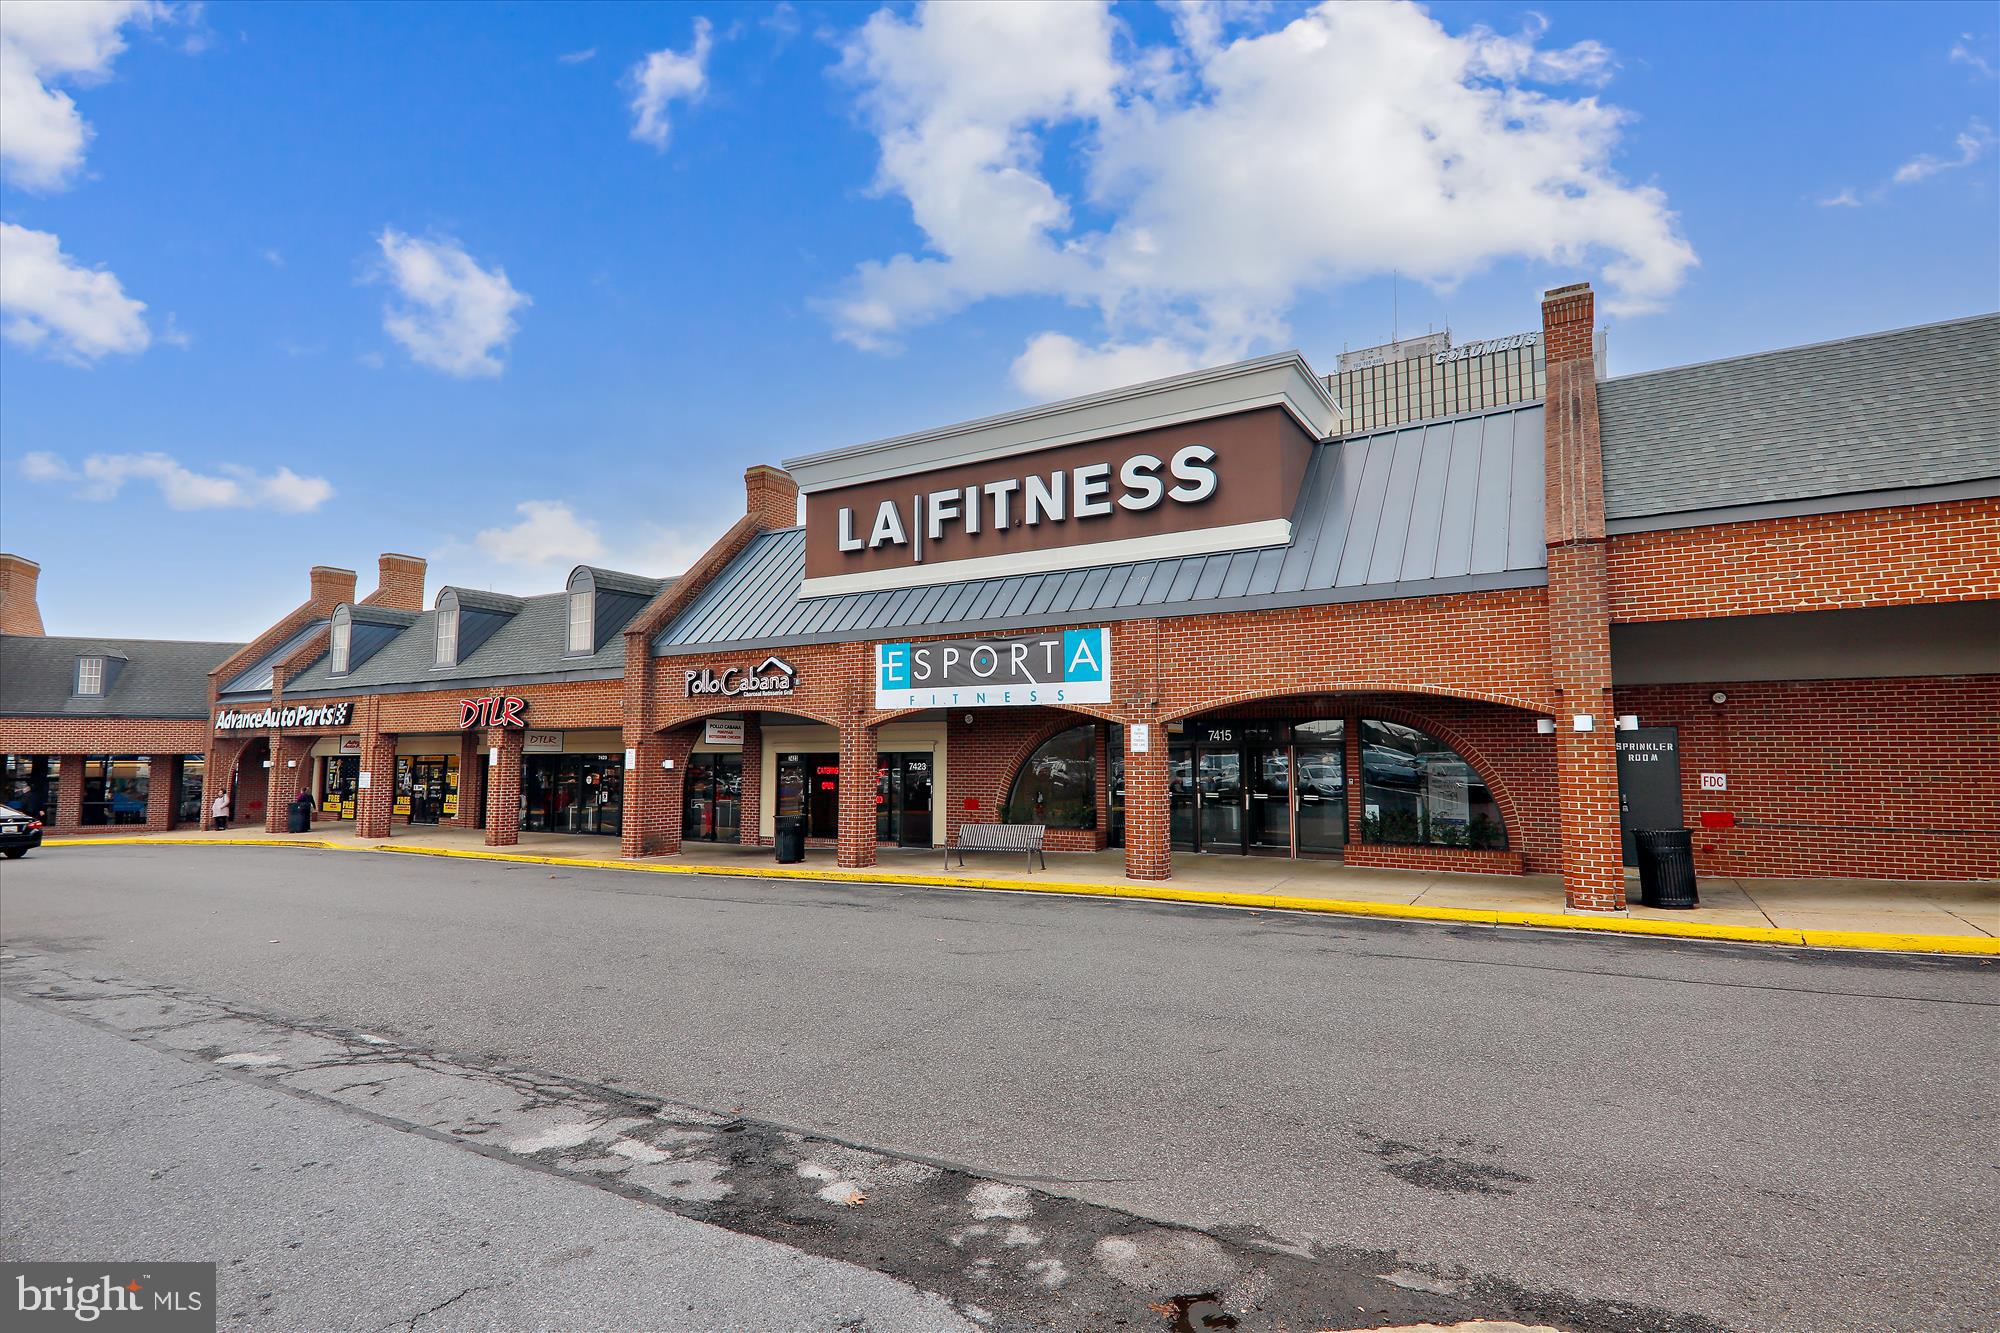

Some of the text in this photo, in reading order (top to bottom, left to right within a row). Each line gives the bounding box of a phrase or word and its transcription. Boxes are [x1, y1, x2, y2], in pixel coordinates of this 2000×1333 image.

[1435, 332, 1537, 365] COLUMBUS
[928, 444, 1218, 540] FITNESS
[881, 637, 1099, 685] ESPORTA
[684, 666, 790, 697] Pollo Cabana
[910, 690, 1064, 705] FITNESS
[460, 696, 525, 729] DTLR
[530, 735, 557, 744] DTLR
[1208, 729, 1232, 742] 7415
[1616, 742, 1674, 751] SPRINKLER
[1628, 753, 1658, 762] ROOM
[908, 762, 927, 771] 7423
[1703, 776, 1724, 787] FDC
[397, 796, 411, 805] FREE
[446, 794, 458, 803] FRE
